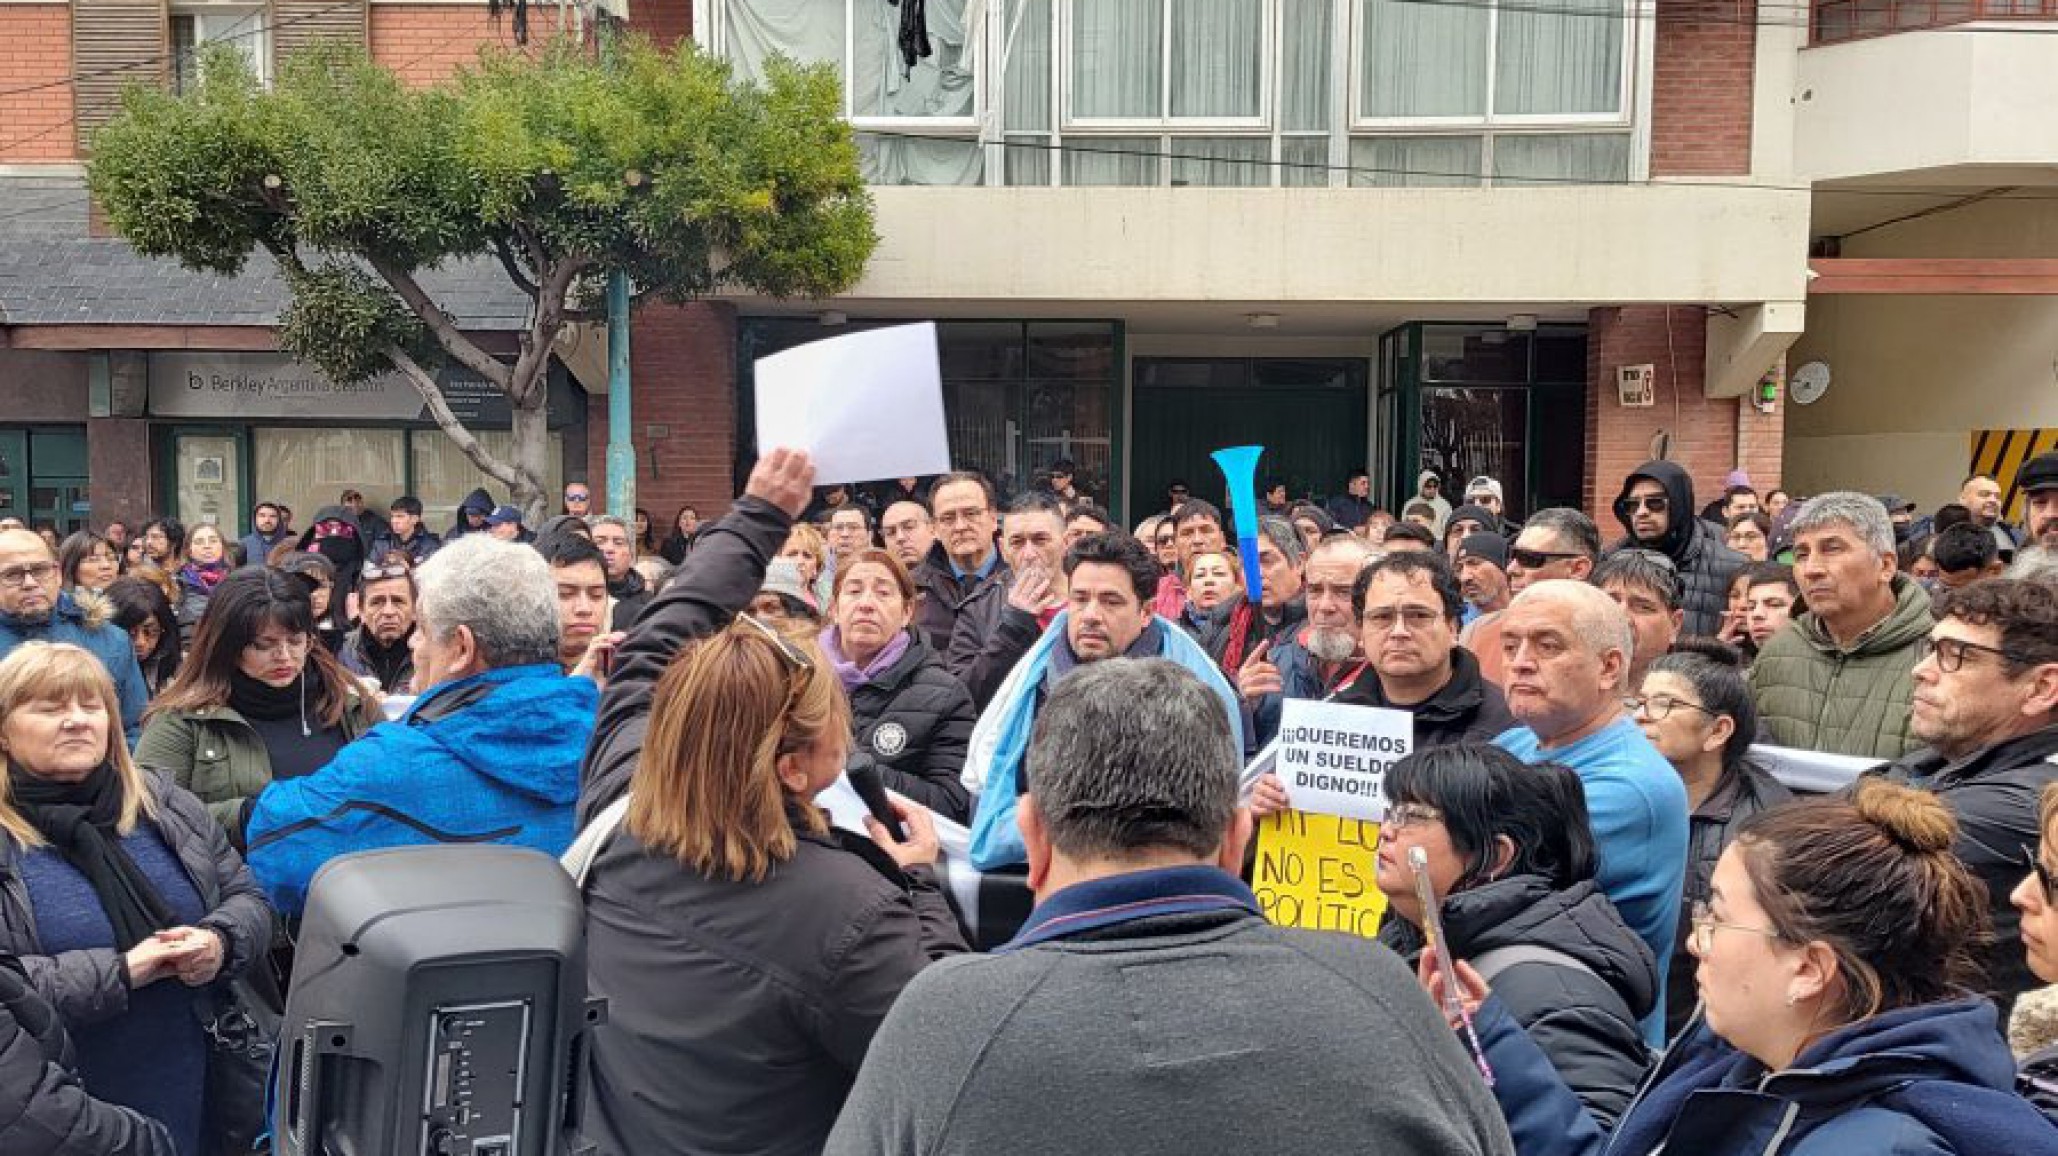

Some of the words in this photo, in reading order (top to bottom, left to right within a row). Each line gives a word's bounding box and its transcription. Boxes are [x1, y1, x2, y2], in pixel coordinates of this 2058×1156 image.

[211, 374, 266, 397] Berkley
[1282, 727, 1406, 754] ¡¡¡QUEREMOS
[1285, 748, 1309, 765] UN
[1296, 771, 1378, 797] DIGNO!!!
[1262, 847, 1304, 886] NO
[1319, 856, 1364, 898] ES
